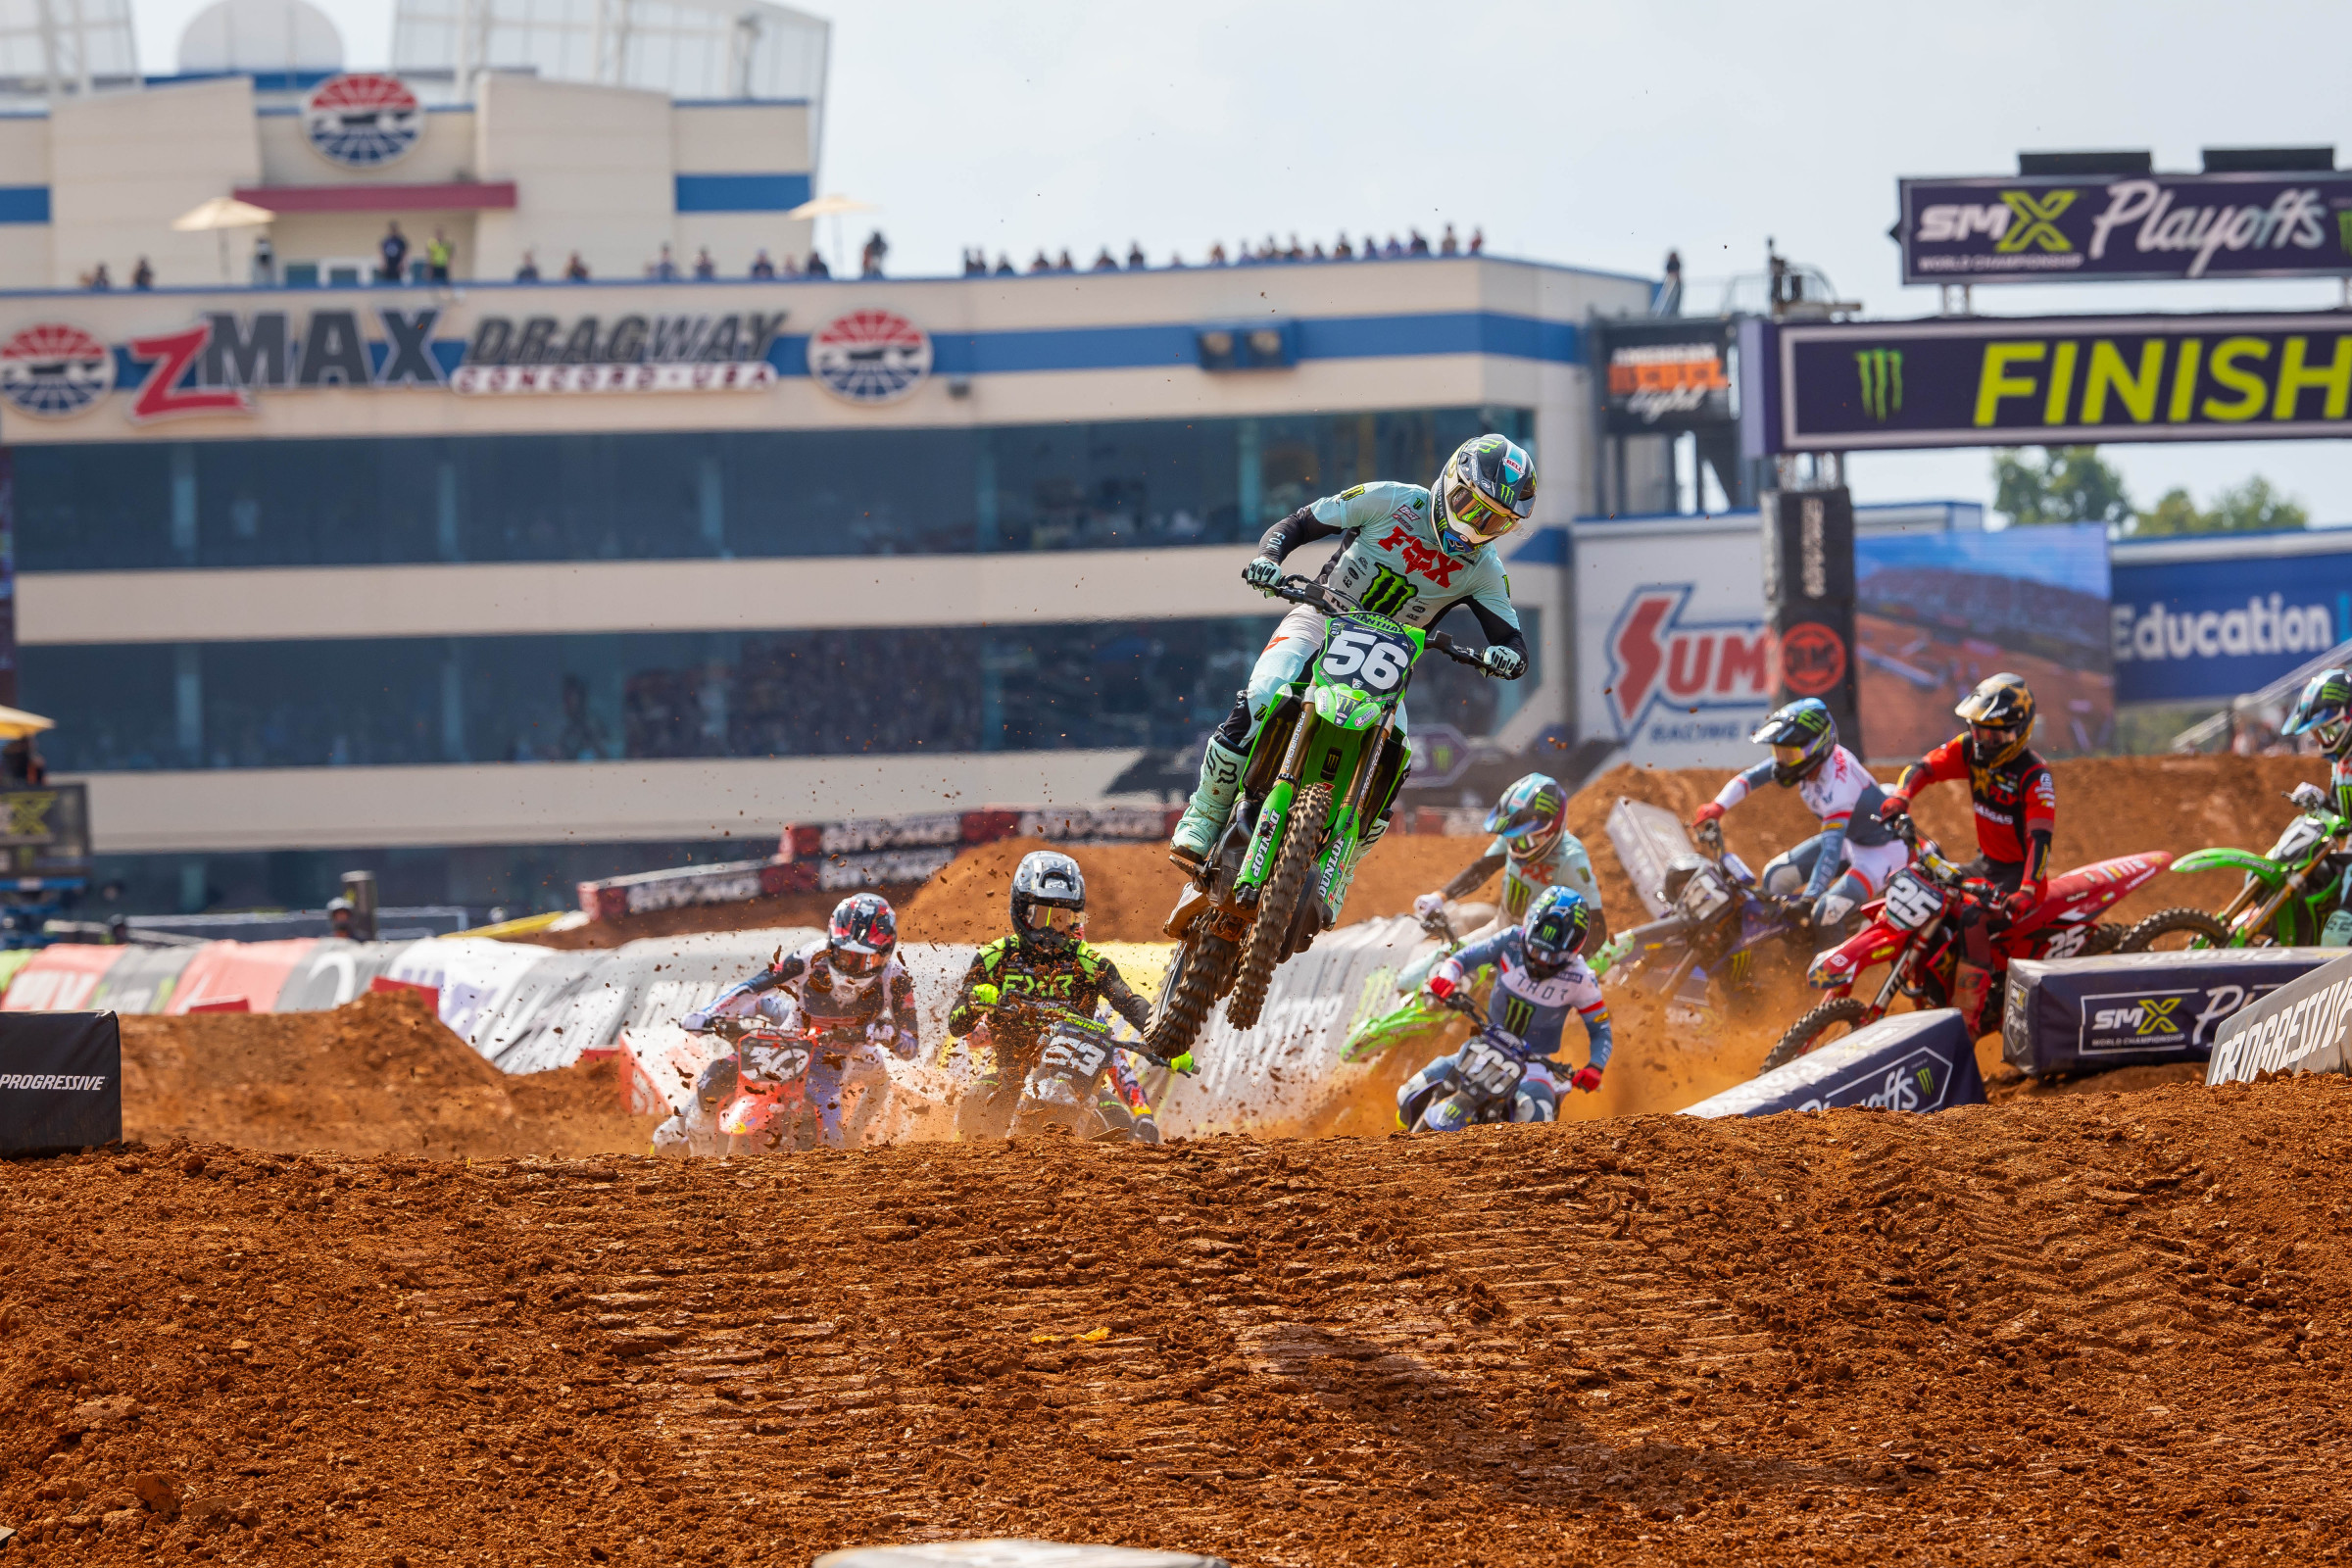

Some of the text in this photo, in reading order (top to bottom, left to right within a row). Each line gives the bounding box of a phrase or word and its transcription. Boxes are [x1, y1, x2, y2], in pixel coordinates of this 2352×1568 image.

[1917, 179, 2326, 278] SMX Playoffs
[462, 310, 790, 364] DRAGWAY
[458, 360, 772, 393] CONCORD USA
[1973, 335, 2352, 427] FINISH
[1505, 458, 1523, 473] BELL
[1265, 531, 1286, 551] FOX
[1377, 525, 1464, 589] FOX
[2111, 591, 2333, 661] Education
[1322, 630, 1409, 690] 56
[1282, 710, 1306, 772] PRO CIRCUIT
[1886, 876, 1943, 928] 25
[2043, 923, 2087, 960] 25
[1002, 974, 1075, 998] FXR
[2091, 998, 2182, 1035] SMX
[2211, 976, 2352, 1086] PROGRESSIVE
[2091, 1033, 2185, 1048] WORLD CHAMPIONSHIP
[0, 1074, 105, 1091] PROGRESSIVE
[741, 1046, 810, 1083] 30
